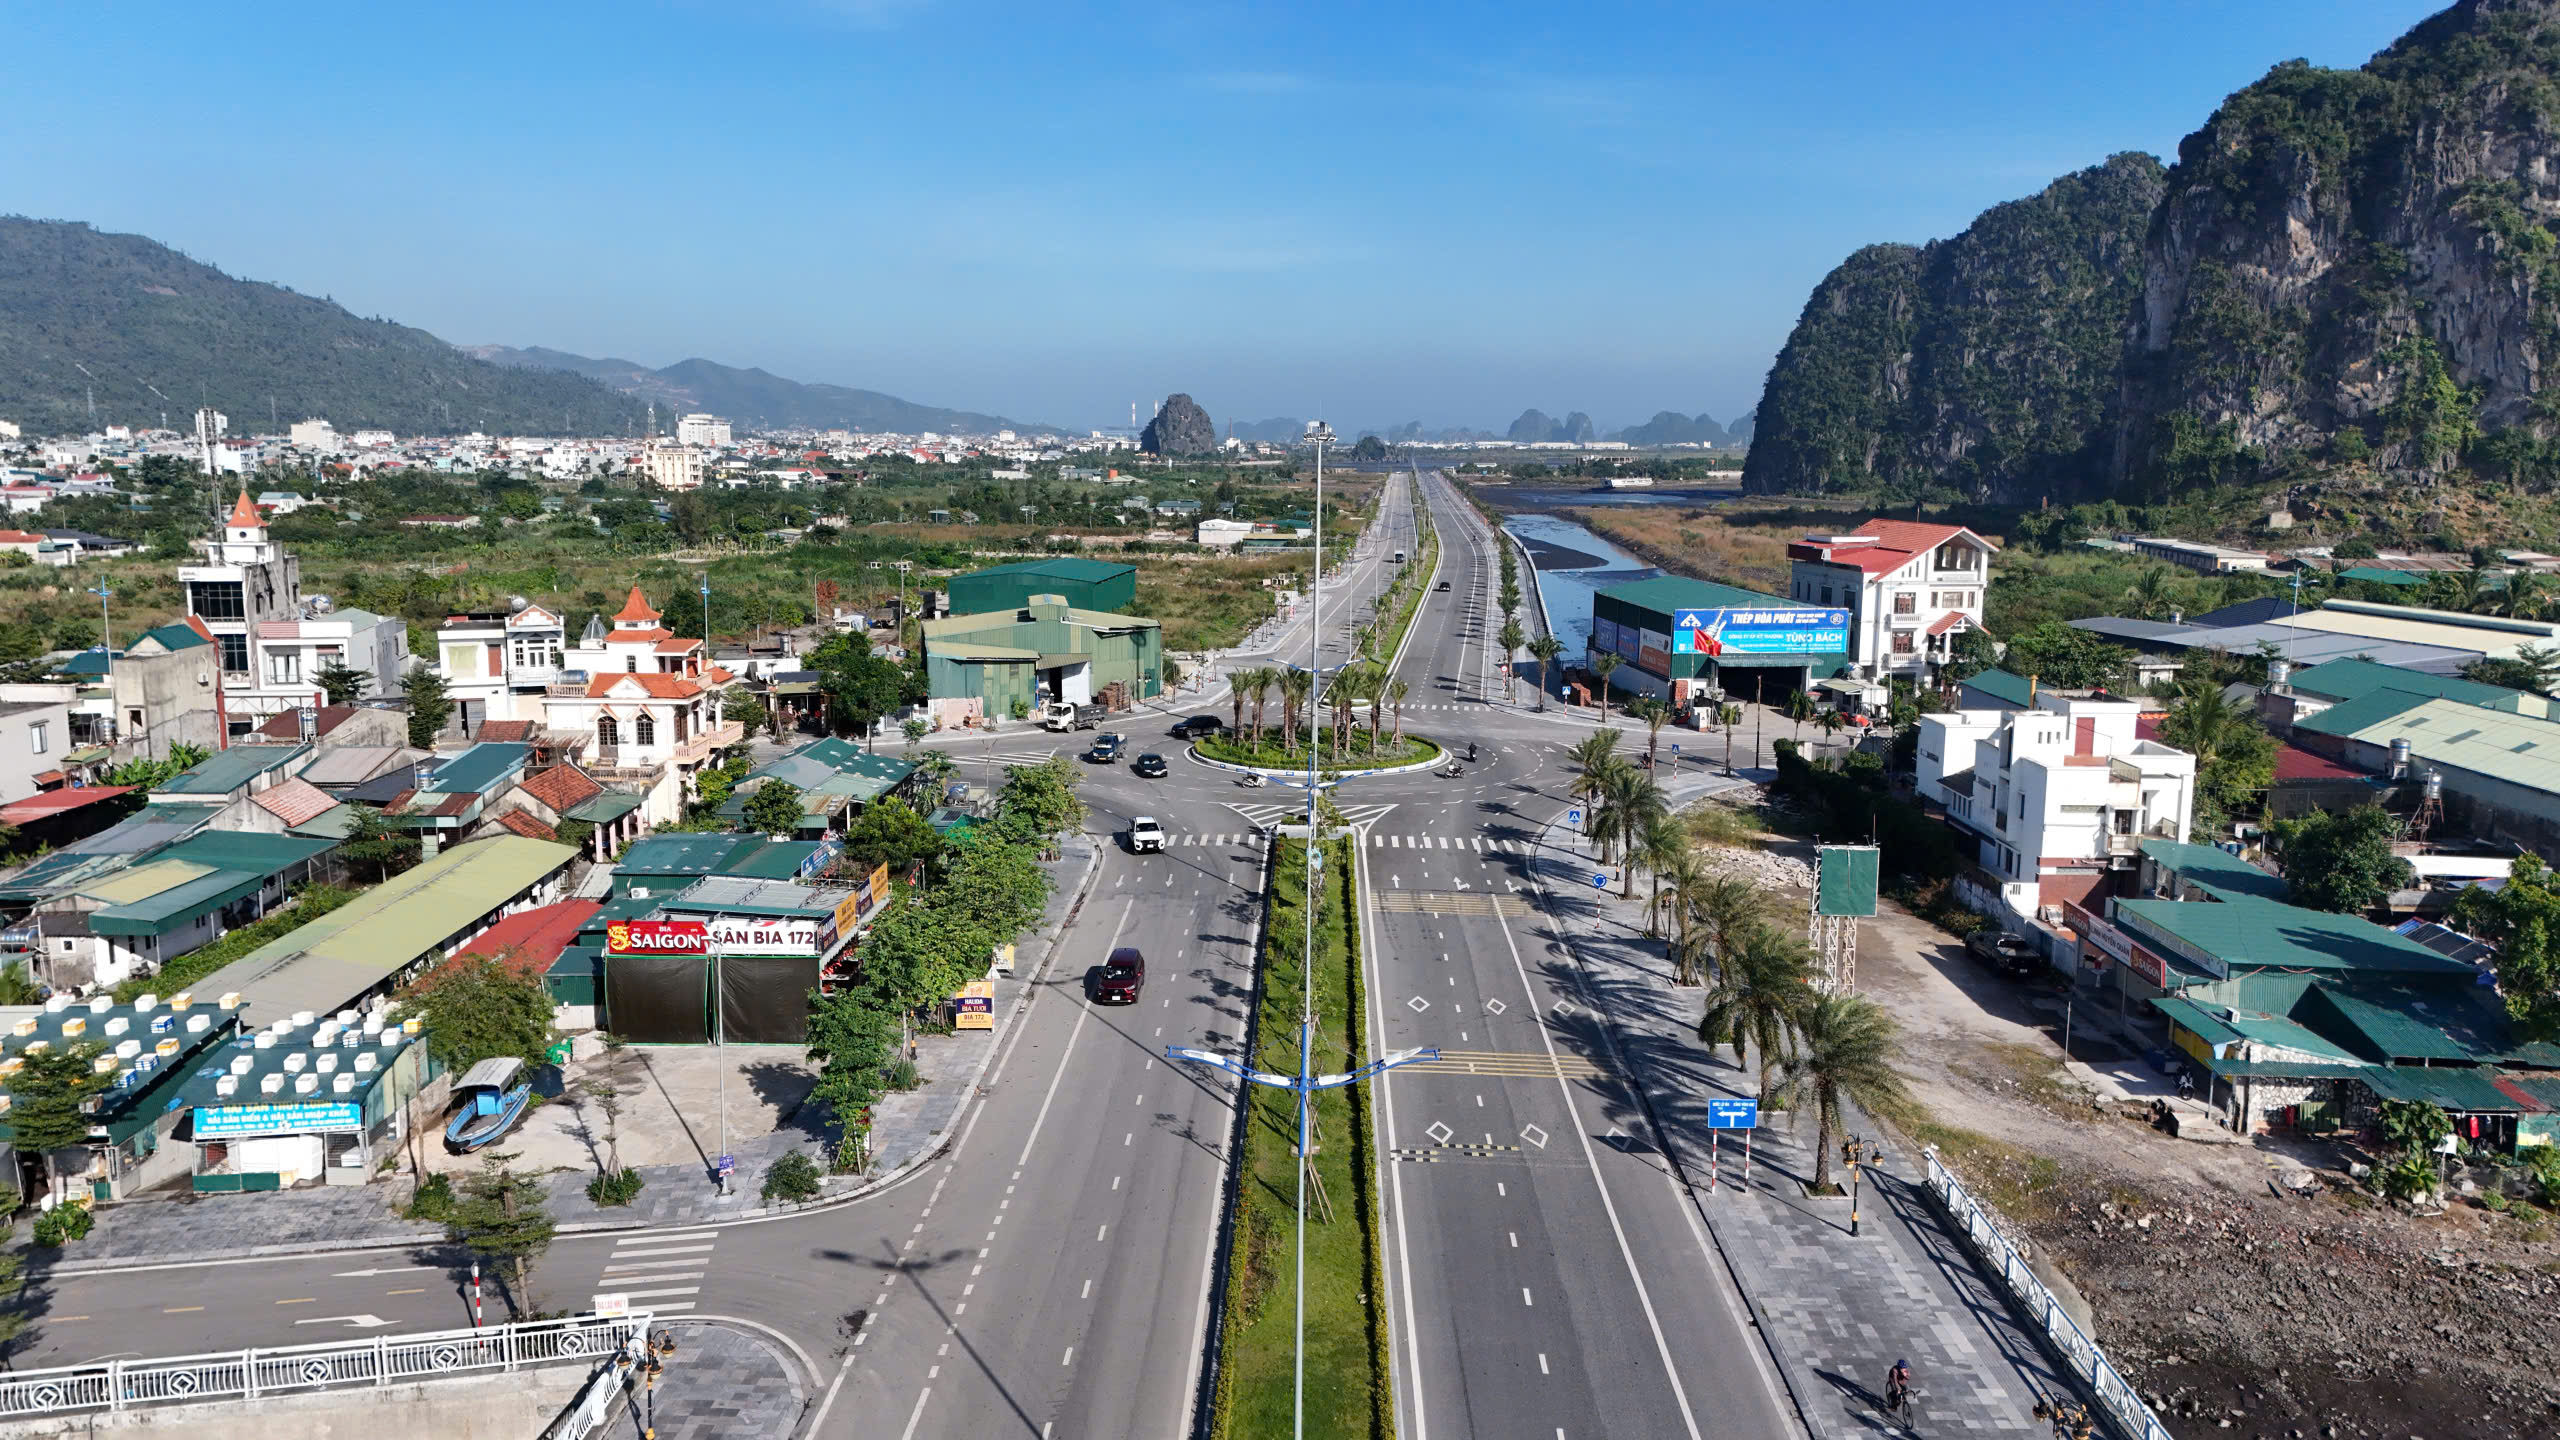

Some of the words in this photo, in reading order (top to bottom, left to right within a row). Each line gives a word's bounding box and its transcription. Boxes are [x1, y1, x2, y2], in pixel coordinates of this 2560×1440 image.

[1732, 611, 1753, 624] THÉP
[1754, 611, 1772, 624] HÒA
[1773, 611, 1796, 624] PHÁT
[1786, 632, 1813, 642] TÙNG
[1816, 631, 1842, 642] BÁCH
[631, 933, 701, 948] SAIGON
[713, 927, 748, 944] SÂN
[754, 931, 783, 944] BIA
[788, 931, 814, 944] 172
[2138, 957, 2161, 980] SAIGON
